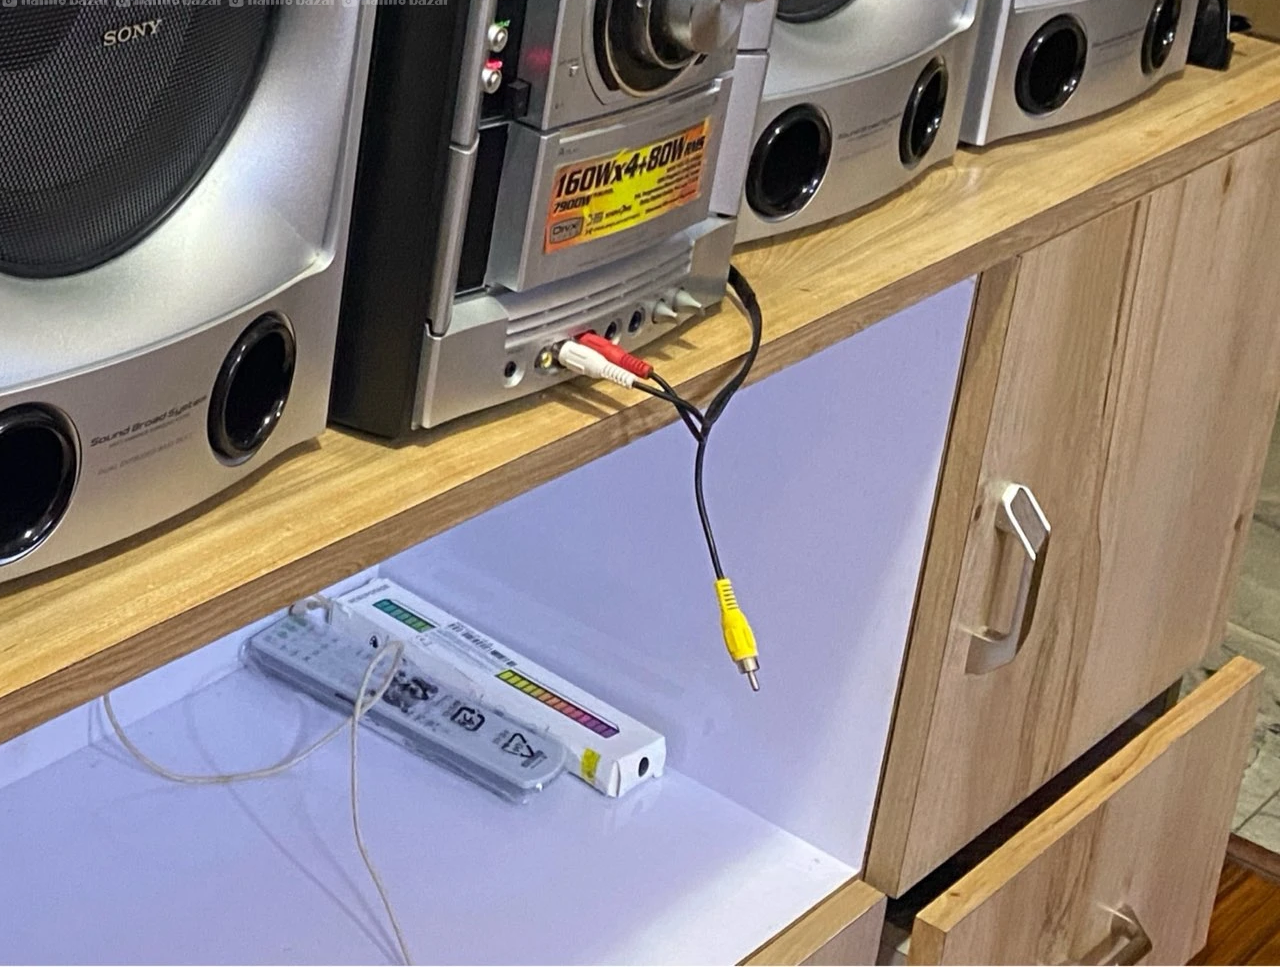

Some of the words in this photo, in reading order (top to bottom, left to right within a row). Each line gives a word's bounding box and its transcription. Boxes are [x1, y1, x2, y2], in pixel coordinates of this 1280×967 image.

[102, 18, 163, 48] SONY
[90, 426, 131, 447] Sound
[131, 411, 168, 432] Broad
